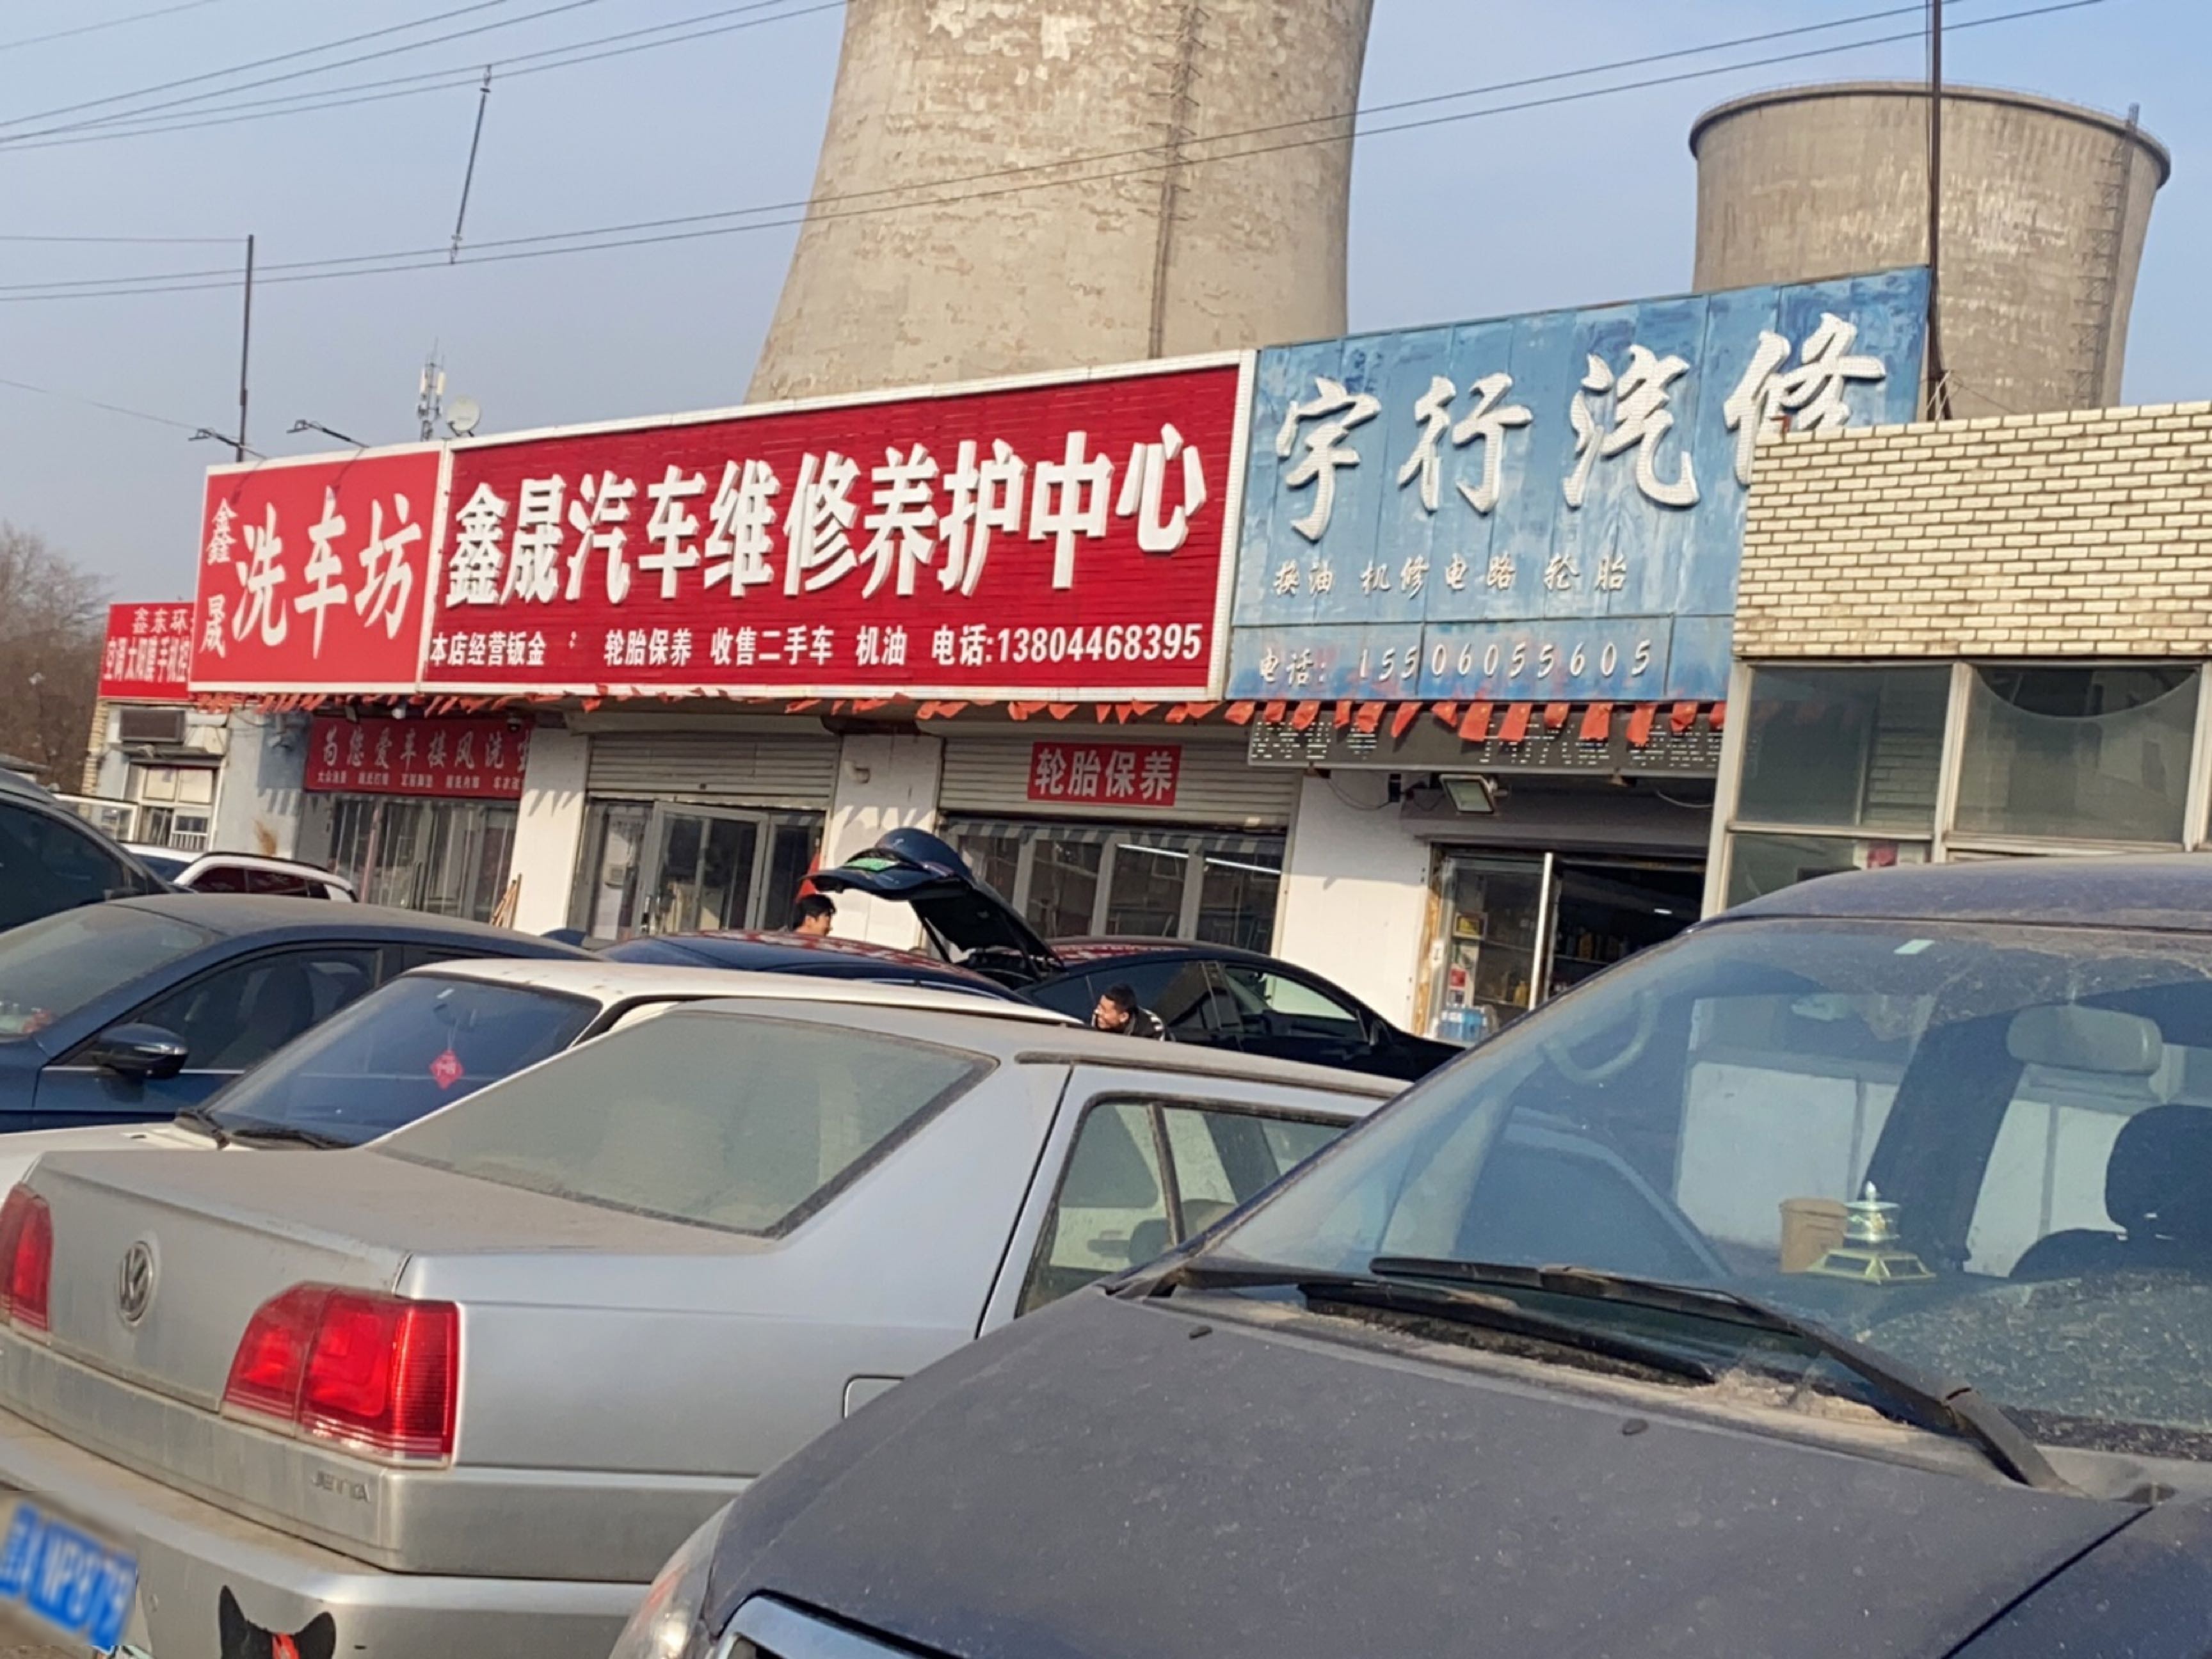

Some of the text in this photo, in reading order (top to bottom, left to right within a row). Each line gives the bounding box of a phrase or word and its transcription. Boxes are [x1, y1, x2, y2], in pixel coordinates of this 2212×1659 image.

[1275, 312, 1886, 543] 宇行汽修
[445, 422, 1207, 609] 鑫晟汽车维修养护中心
[198, 497, 239, 659] 鑫晟
[232, 486, 422, 660] 洗车坊
[1273, 563, 1336, 597] 换油
[1543, 552, 1630, 592] 轮胎
[132, 606, 194, 636] 鑫东环
[429, 623, 1203, 668] 本店经营钣金 轮胎保养 收售二手车 机油 电话:13804468395
[1034, 748, 1173, 801] 轮胎保养
[310, 1470, 371, 1503] JETTA
